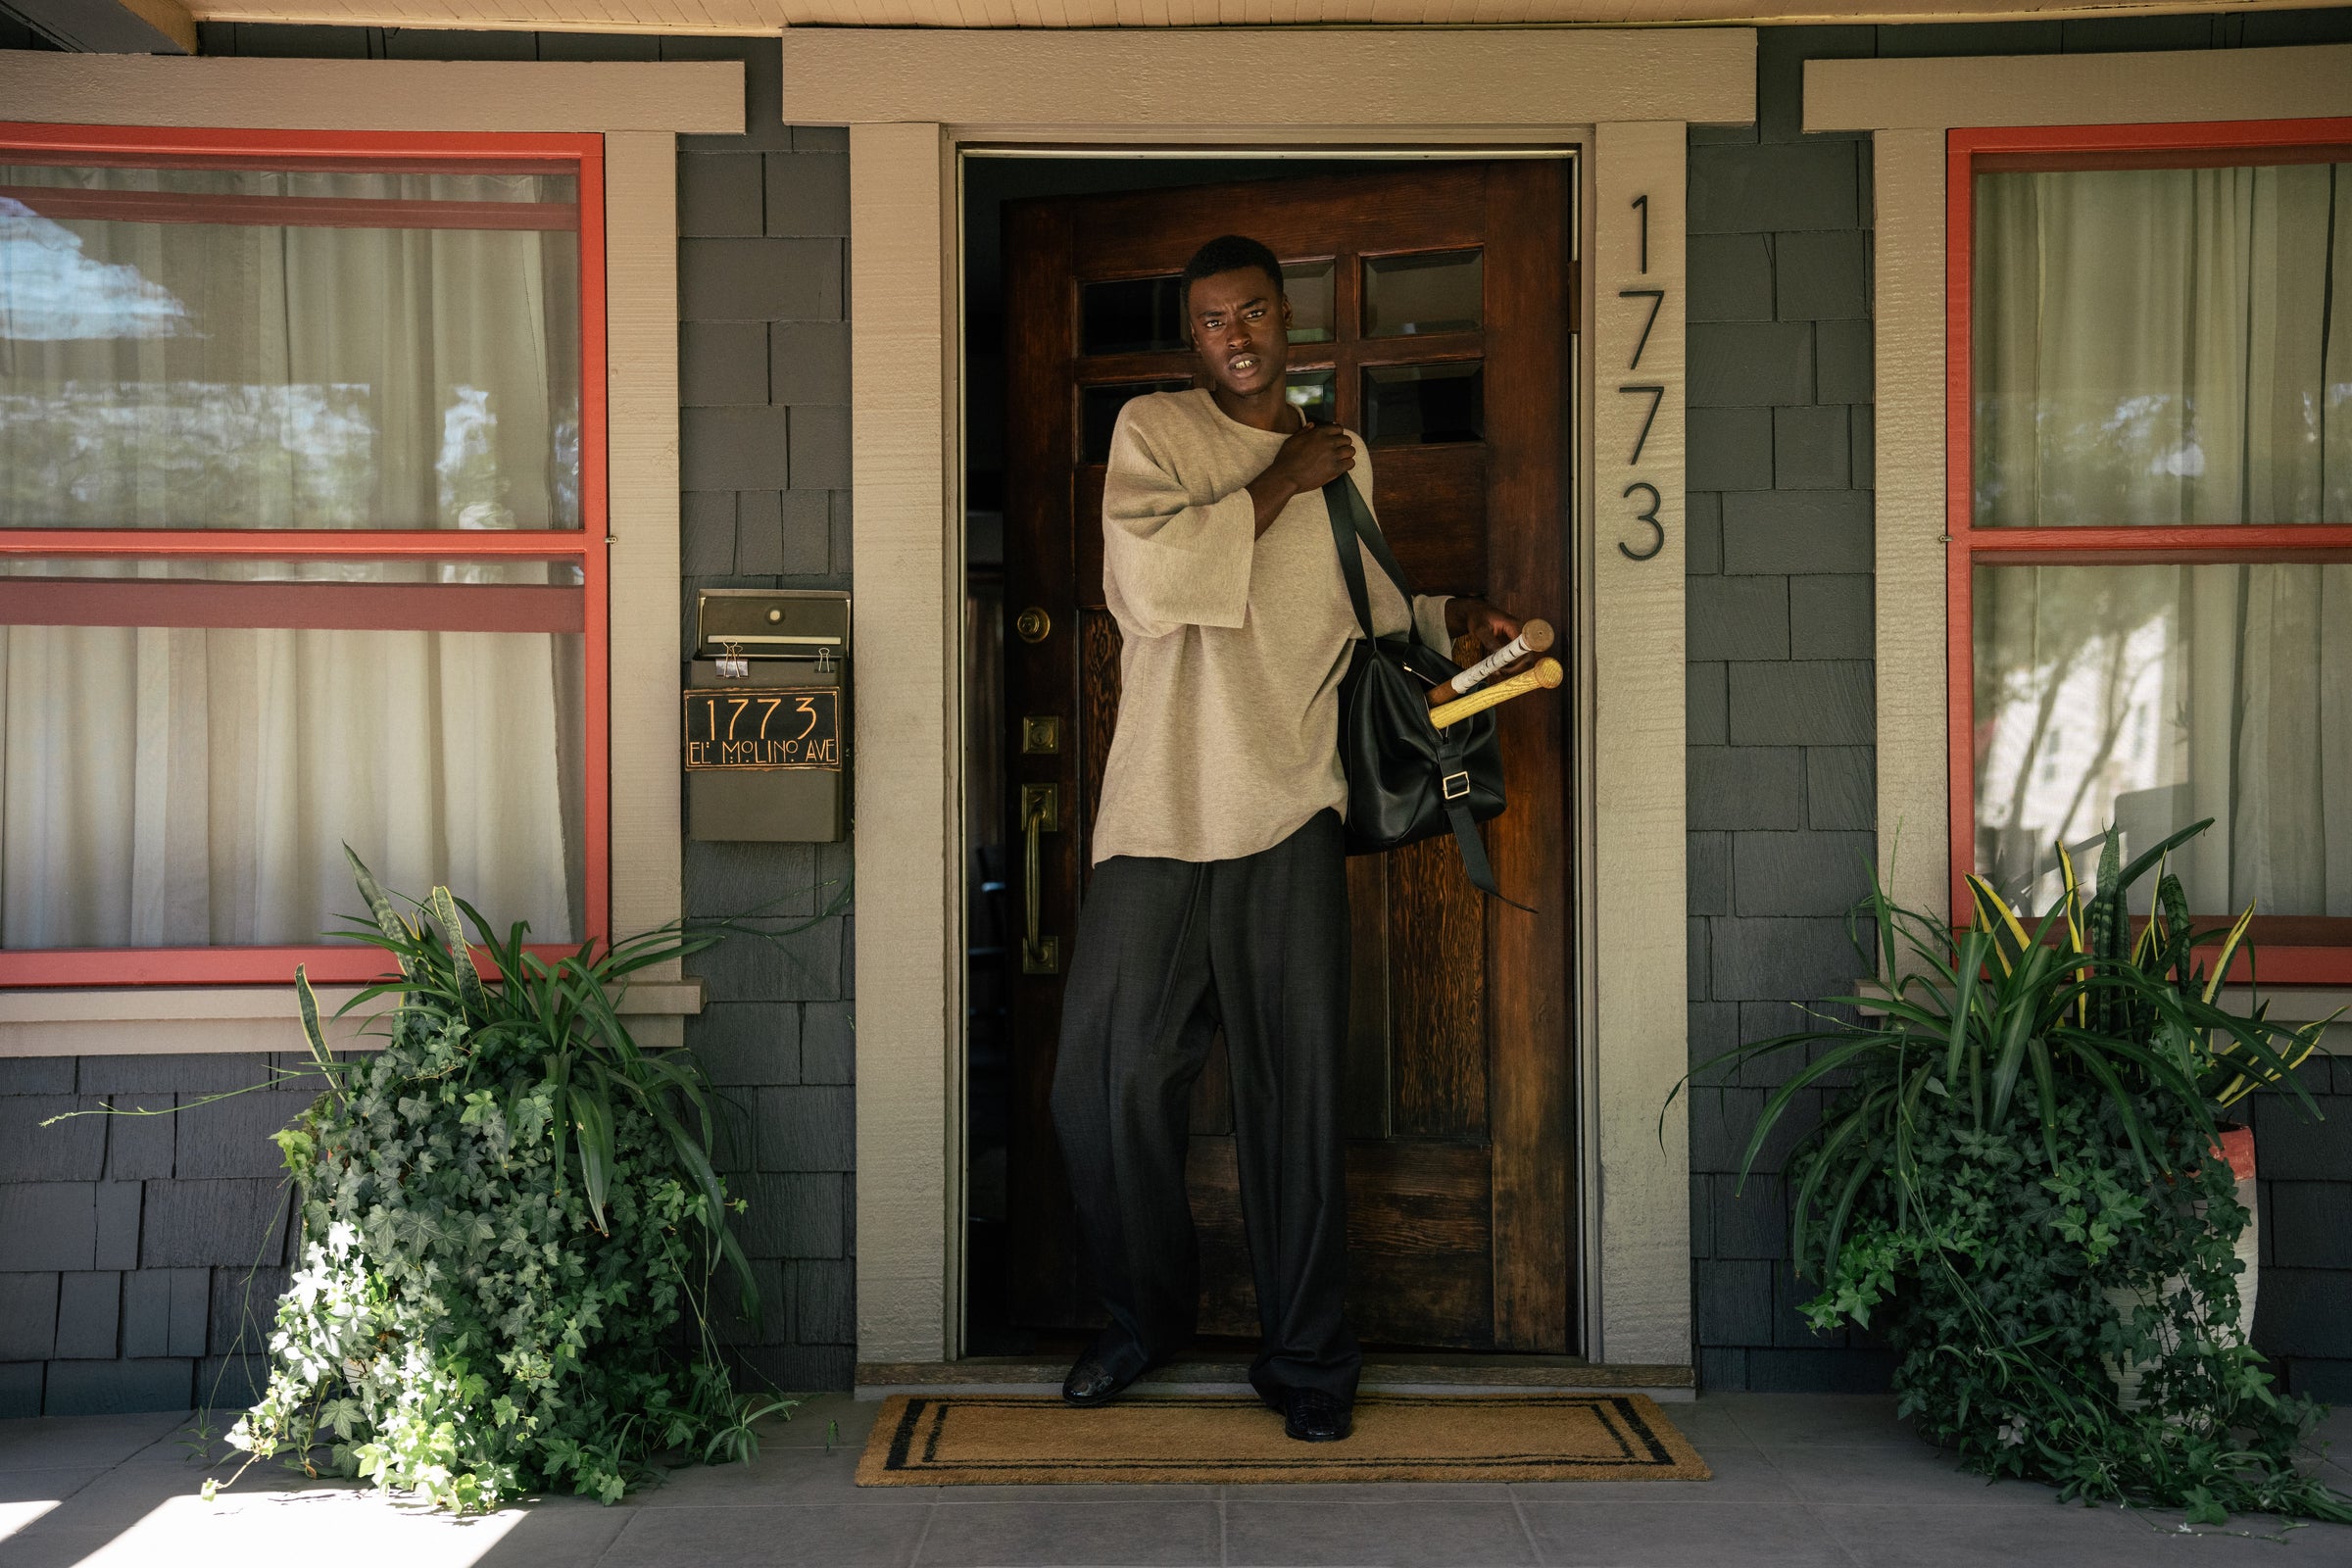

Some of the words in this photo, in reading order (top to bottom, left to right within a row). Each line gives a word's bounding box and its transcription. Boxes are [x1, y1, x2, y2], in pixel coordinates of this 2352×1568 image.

[1619, 194, 1664, 561] 1773
[707, 697, 817, 740] 1773
[806, 739, 835, 762] AVE
